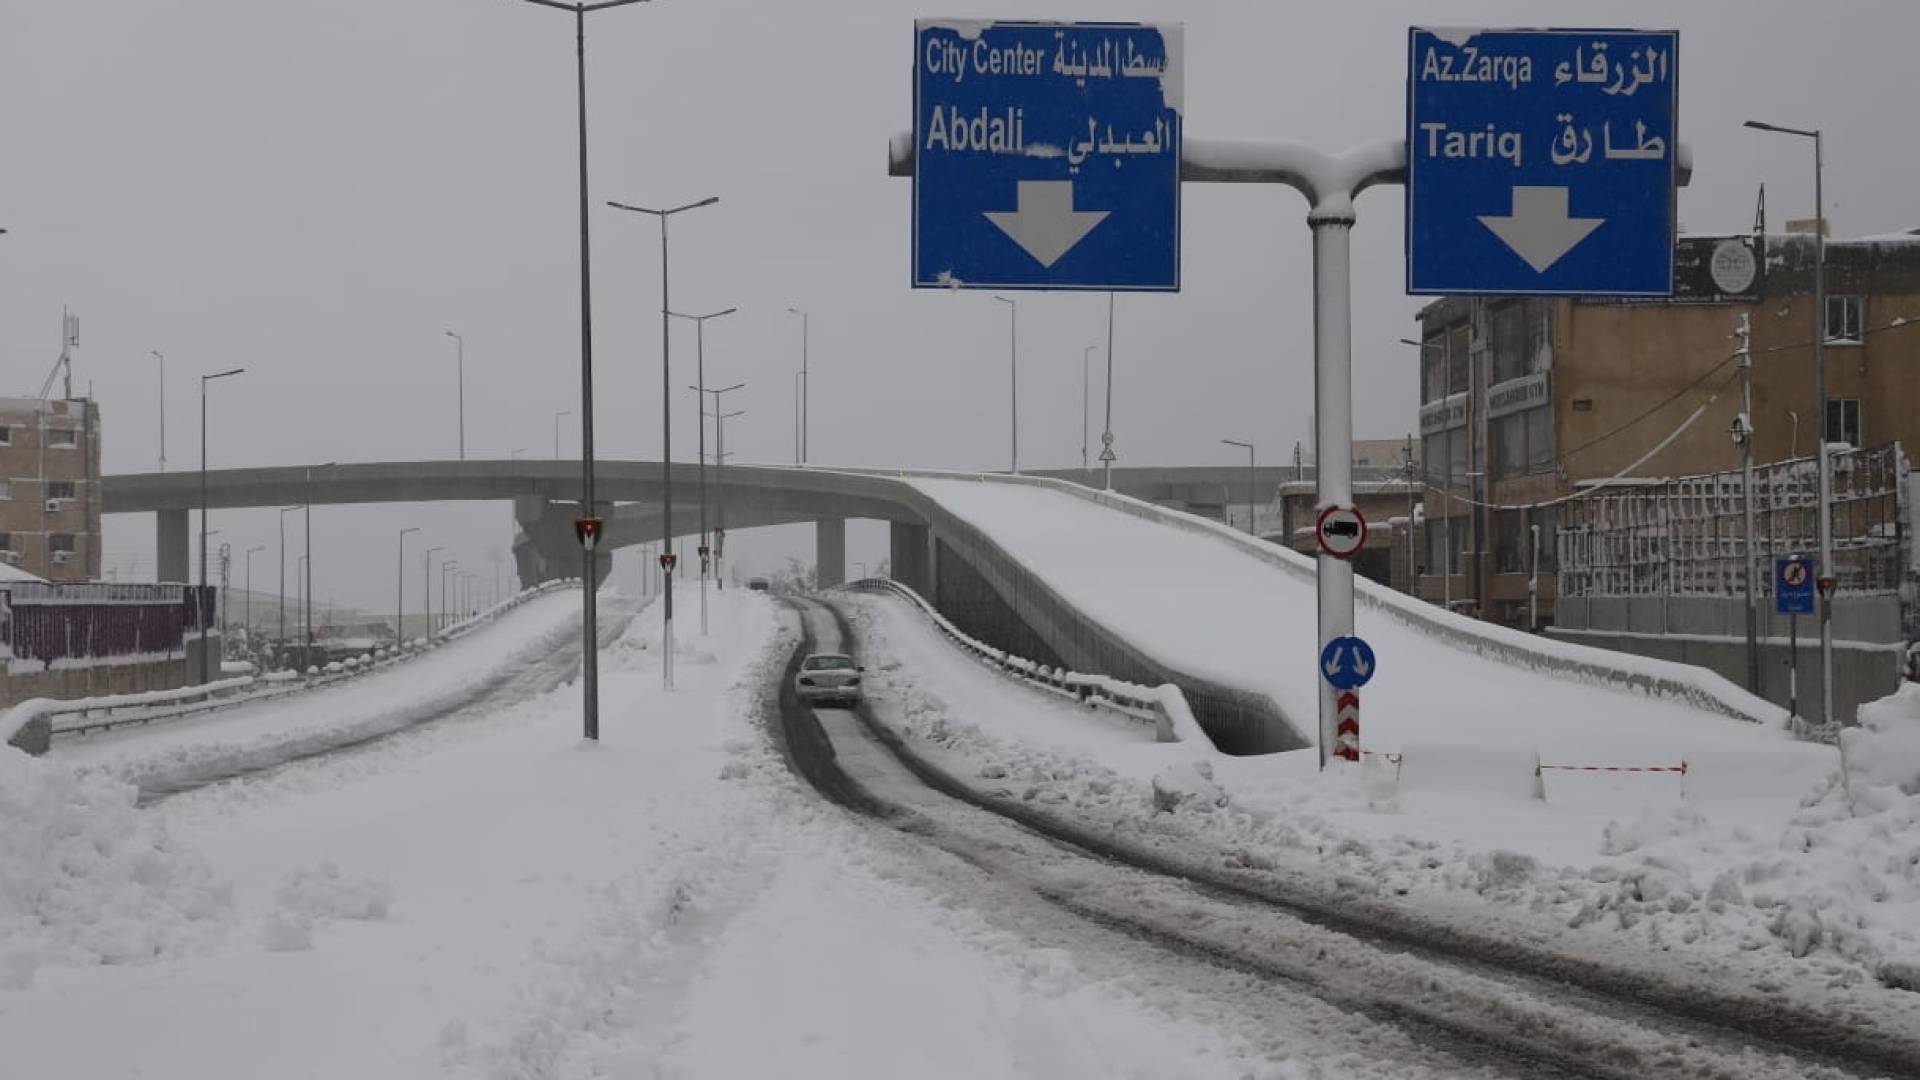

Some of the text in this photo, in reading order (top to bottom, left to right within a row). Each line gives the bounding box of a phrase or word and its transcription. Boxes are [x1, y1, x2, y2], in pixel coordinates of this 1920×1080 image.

[926, 37, 1044, 83] City Center
[1053, 31, 1120, 88] المدينة
[1422, 46, 1532, 89] Az.Zarqa
[1554, 41, 1667, 96] الزرقاء
[927, 105, 1024, 151] Abdali
[1068, 115, 1171, 174] العبدلي
[1420, 122, 1522, 167] Tariq
[1551, 113, 1665, 165] طارق
